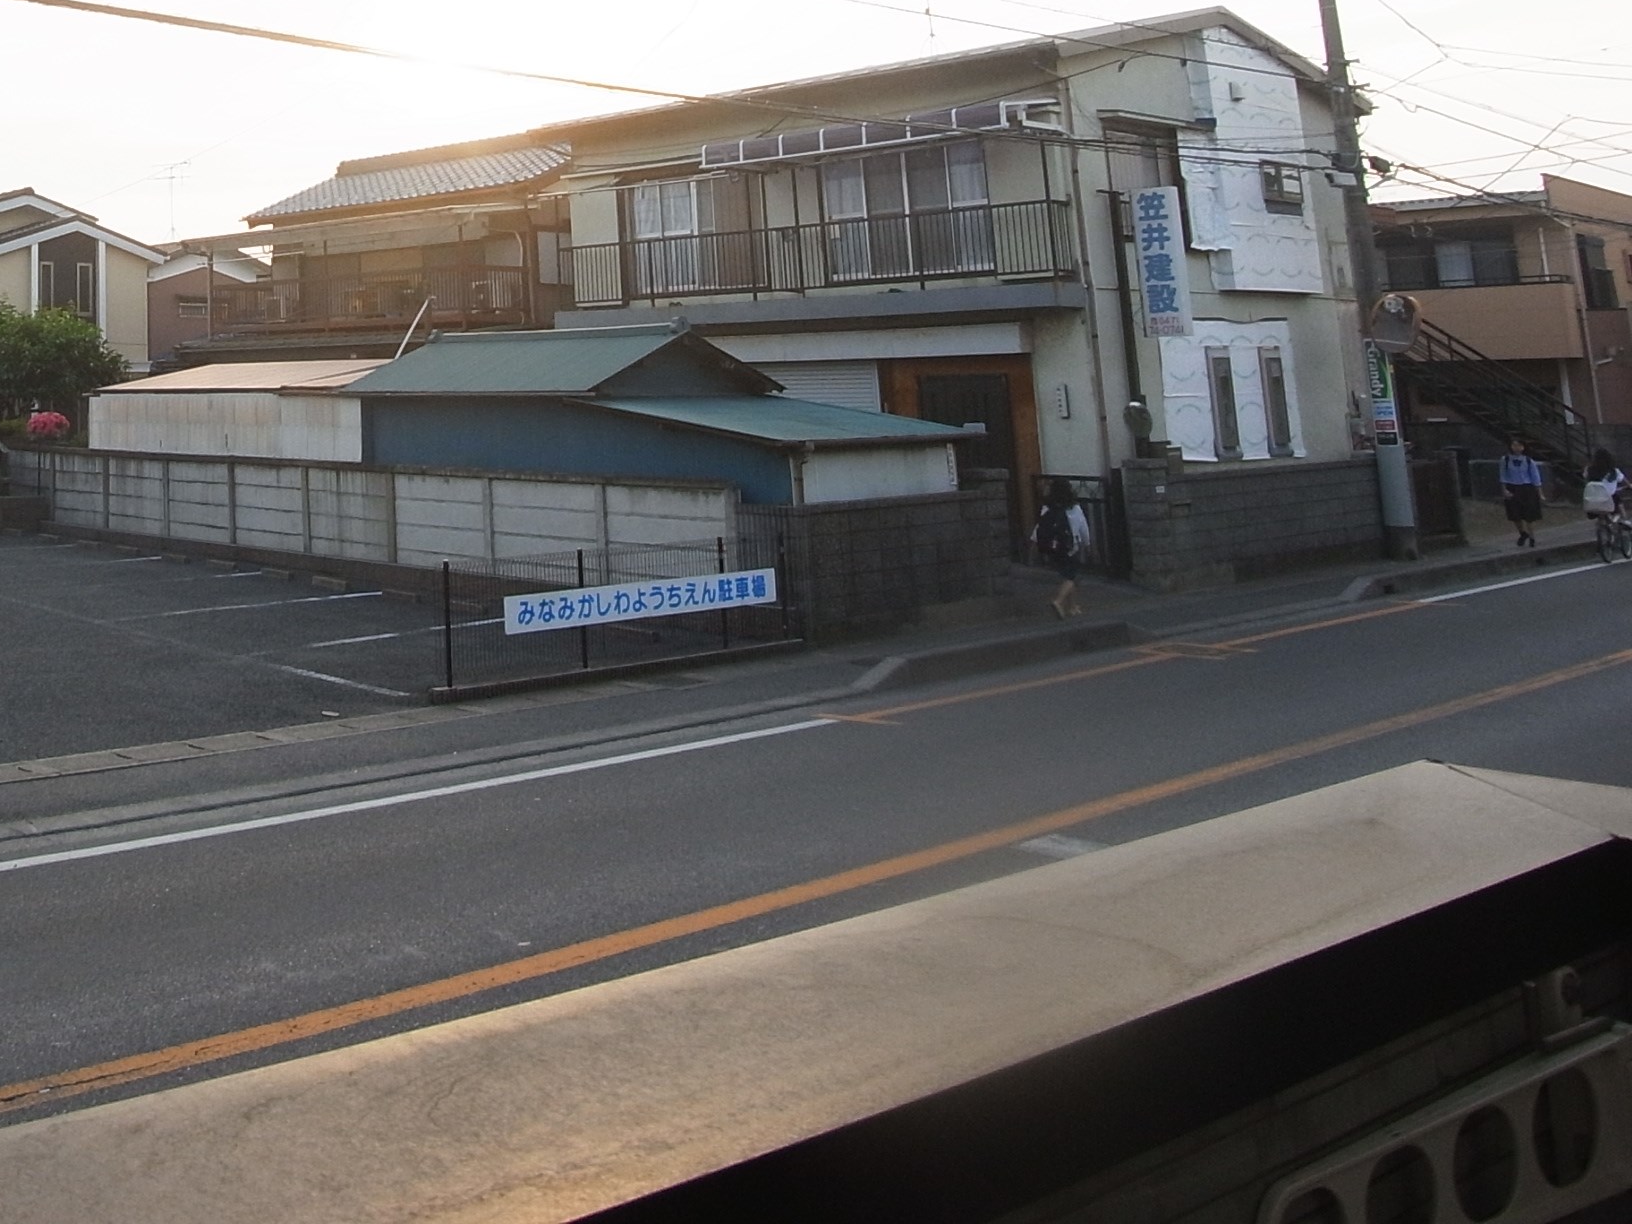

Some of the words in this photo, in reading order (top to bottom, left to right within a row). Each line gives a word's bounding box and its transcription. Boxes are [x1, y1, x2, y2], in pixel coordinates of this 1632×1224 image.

[1136, 191, 1180, 314] 笠井建設
[1368, 348, 1384, 396] Grandy
[517, 574, 766, 625] みなみかしわようちえん駐車場
